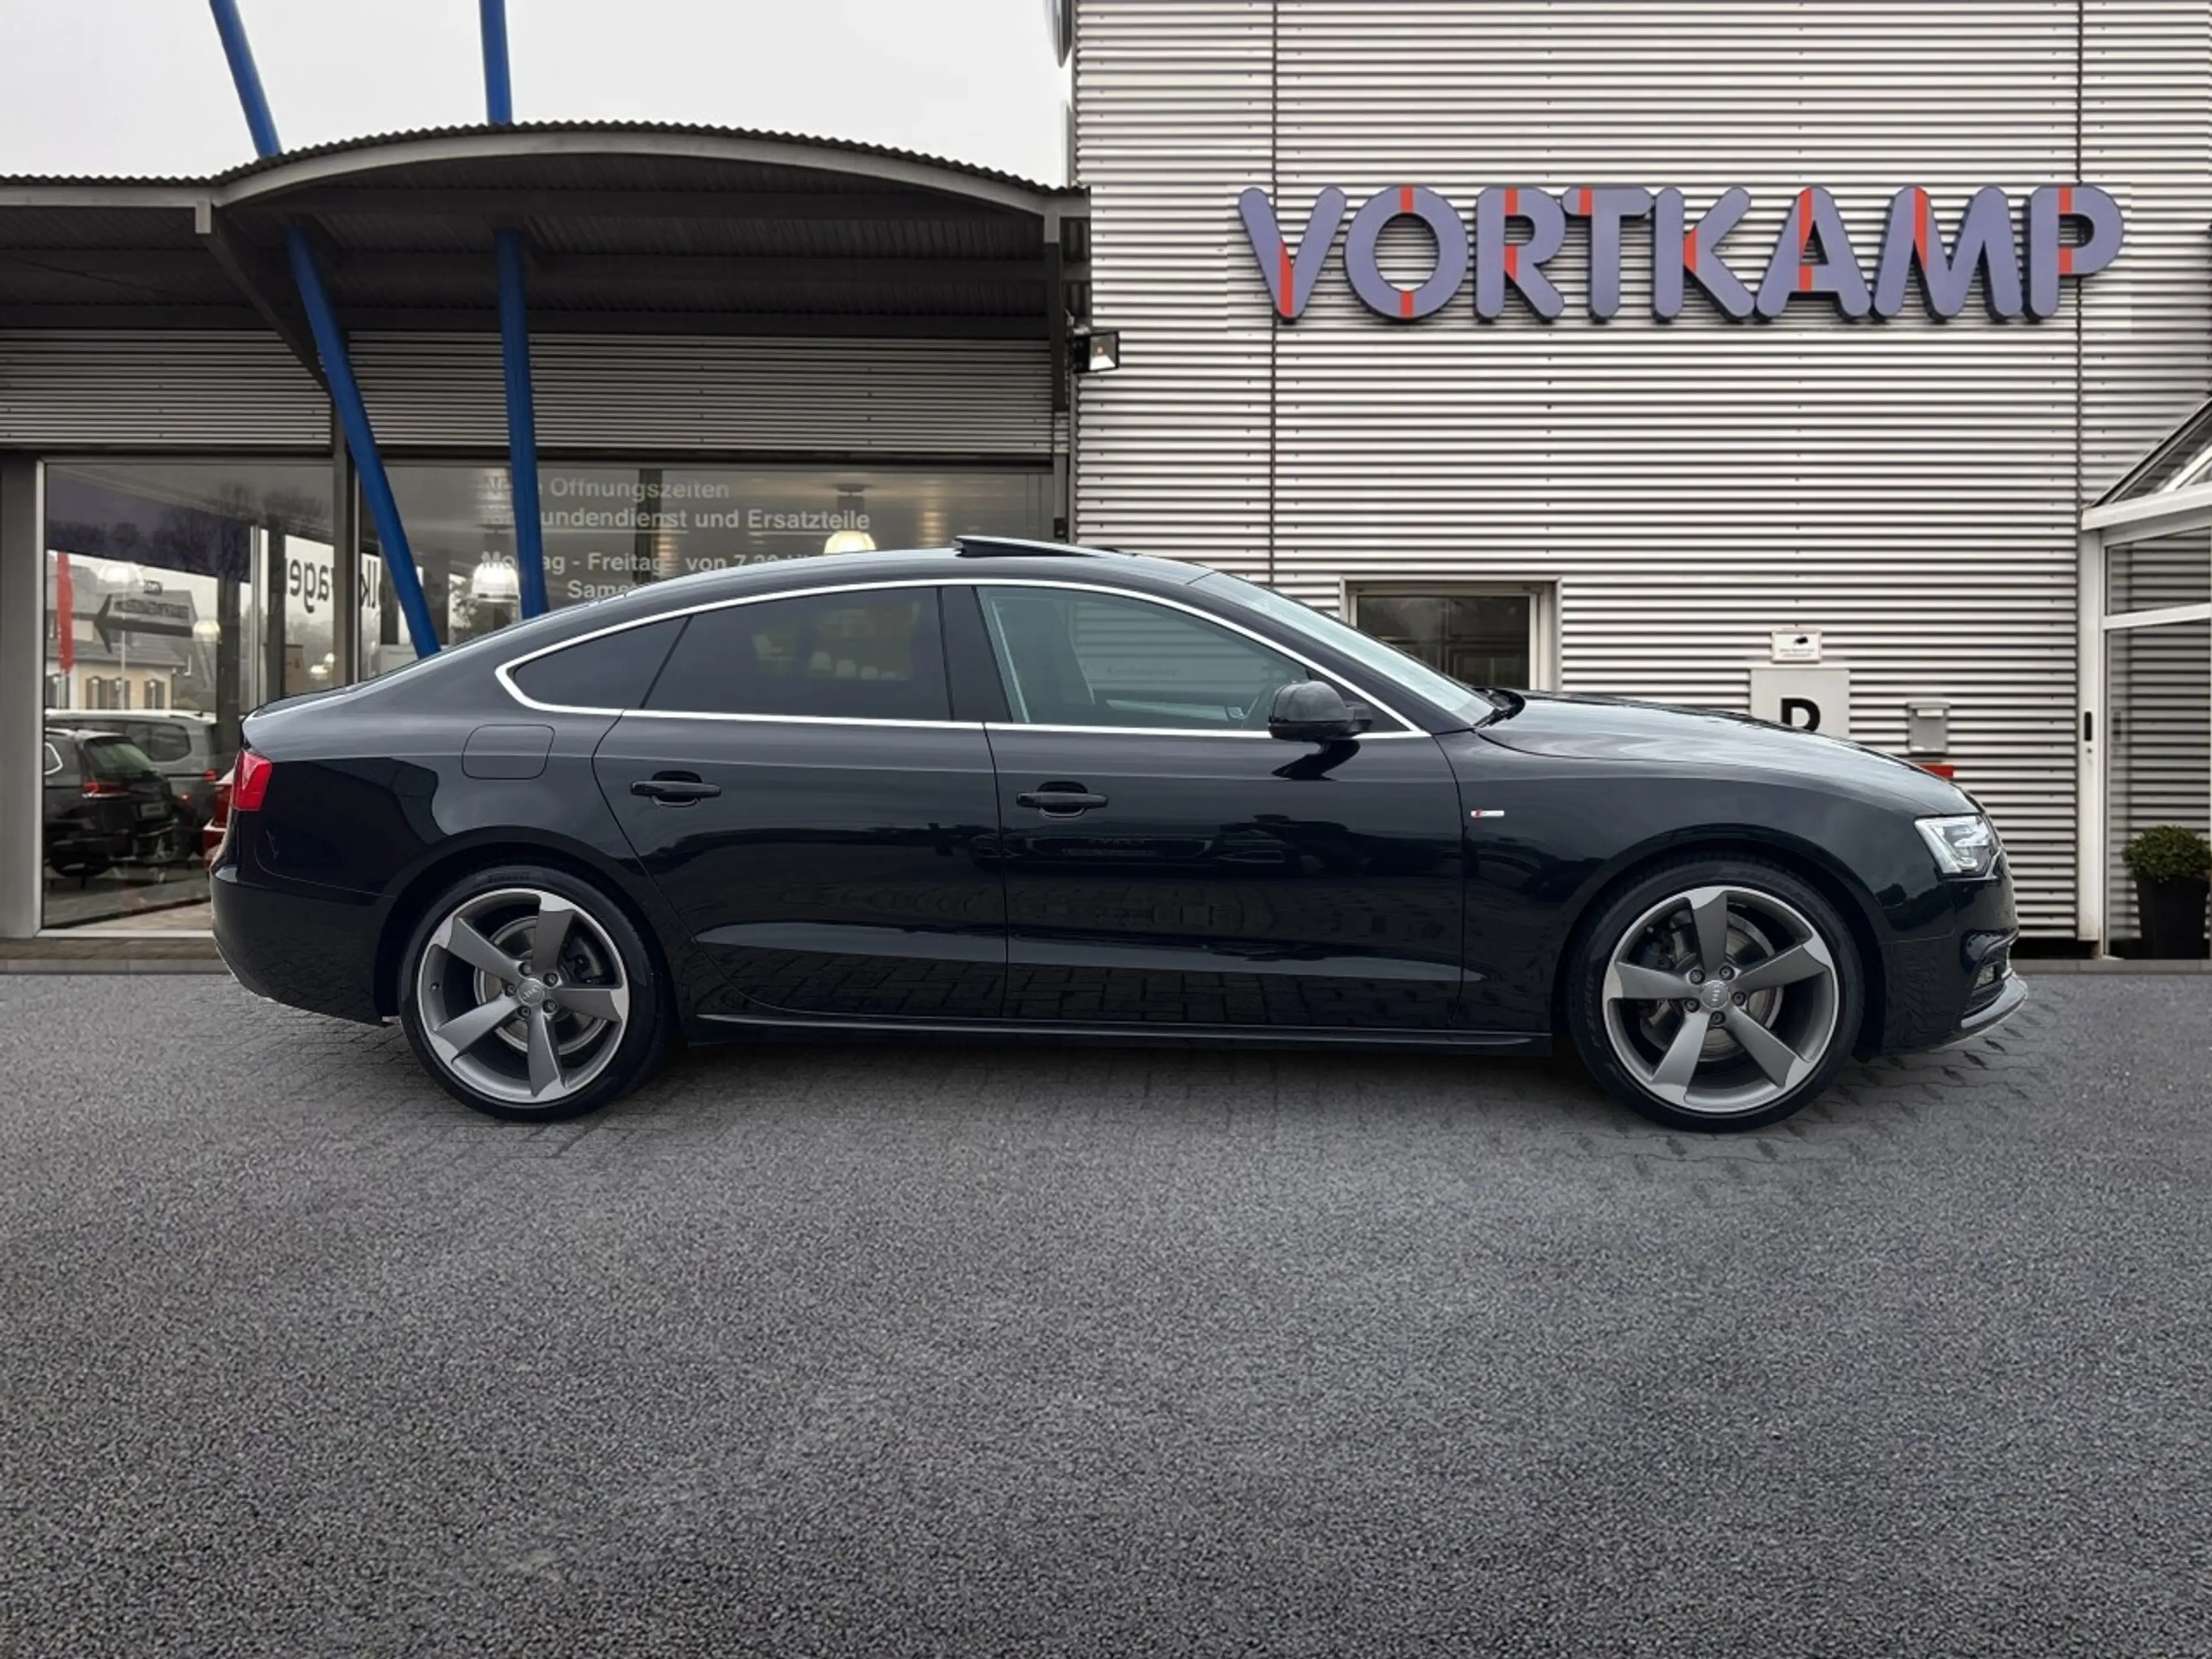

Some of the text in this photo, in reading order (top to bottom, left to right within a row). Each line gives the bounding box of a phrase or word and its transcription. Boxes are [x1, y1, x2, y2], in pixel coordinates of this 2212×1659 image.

[1238, 185, 2124, 319] VORTKAMP
[540, 507, 688, 528] undendienst
[695, 509, 739, 528] und
[748, 509, 870, 529] Ersatzteile
[481, 551, 566, 575] Moag
[588, 552, 666, 576] Freitag
[685, 556, 727, 571] von
